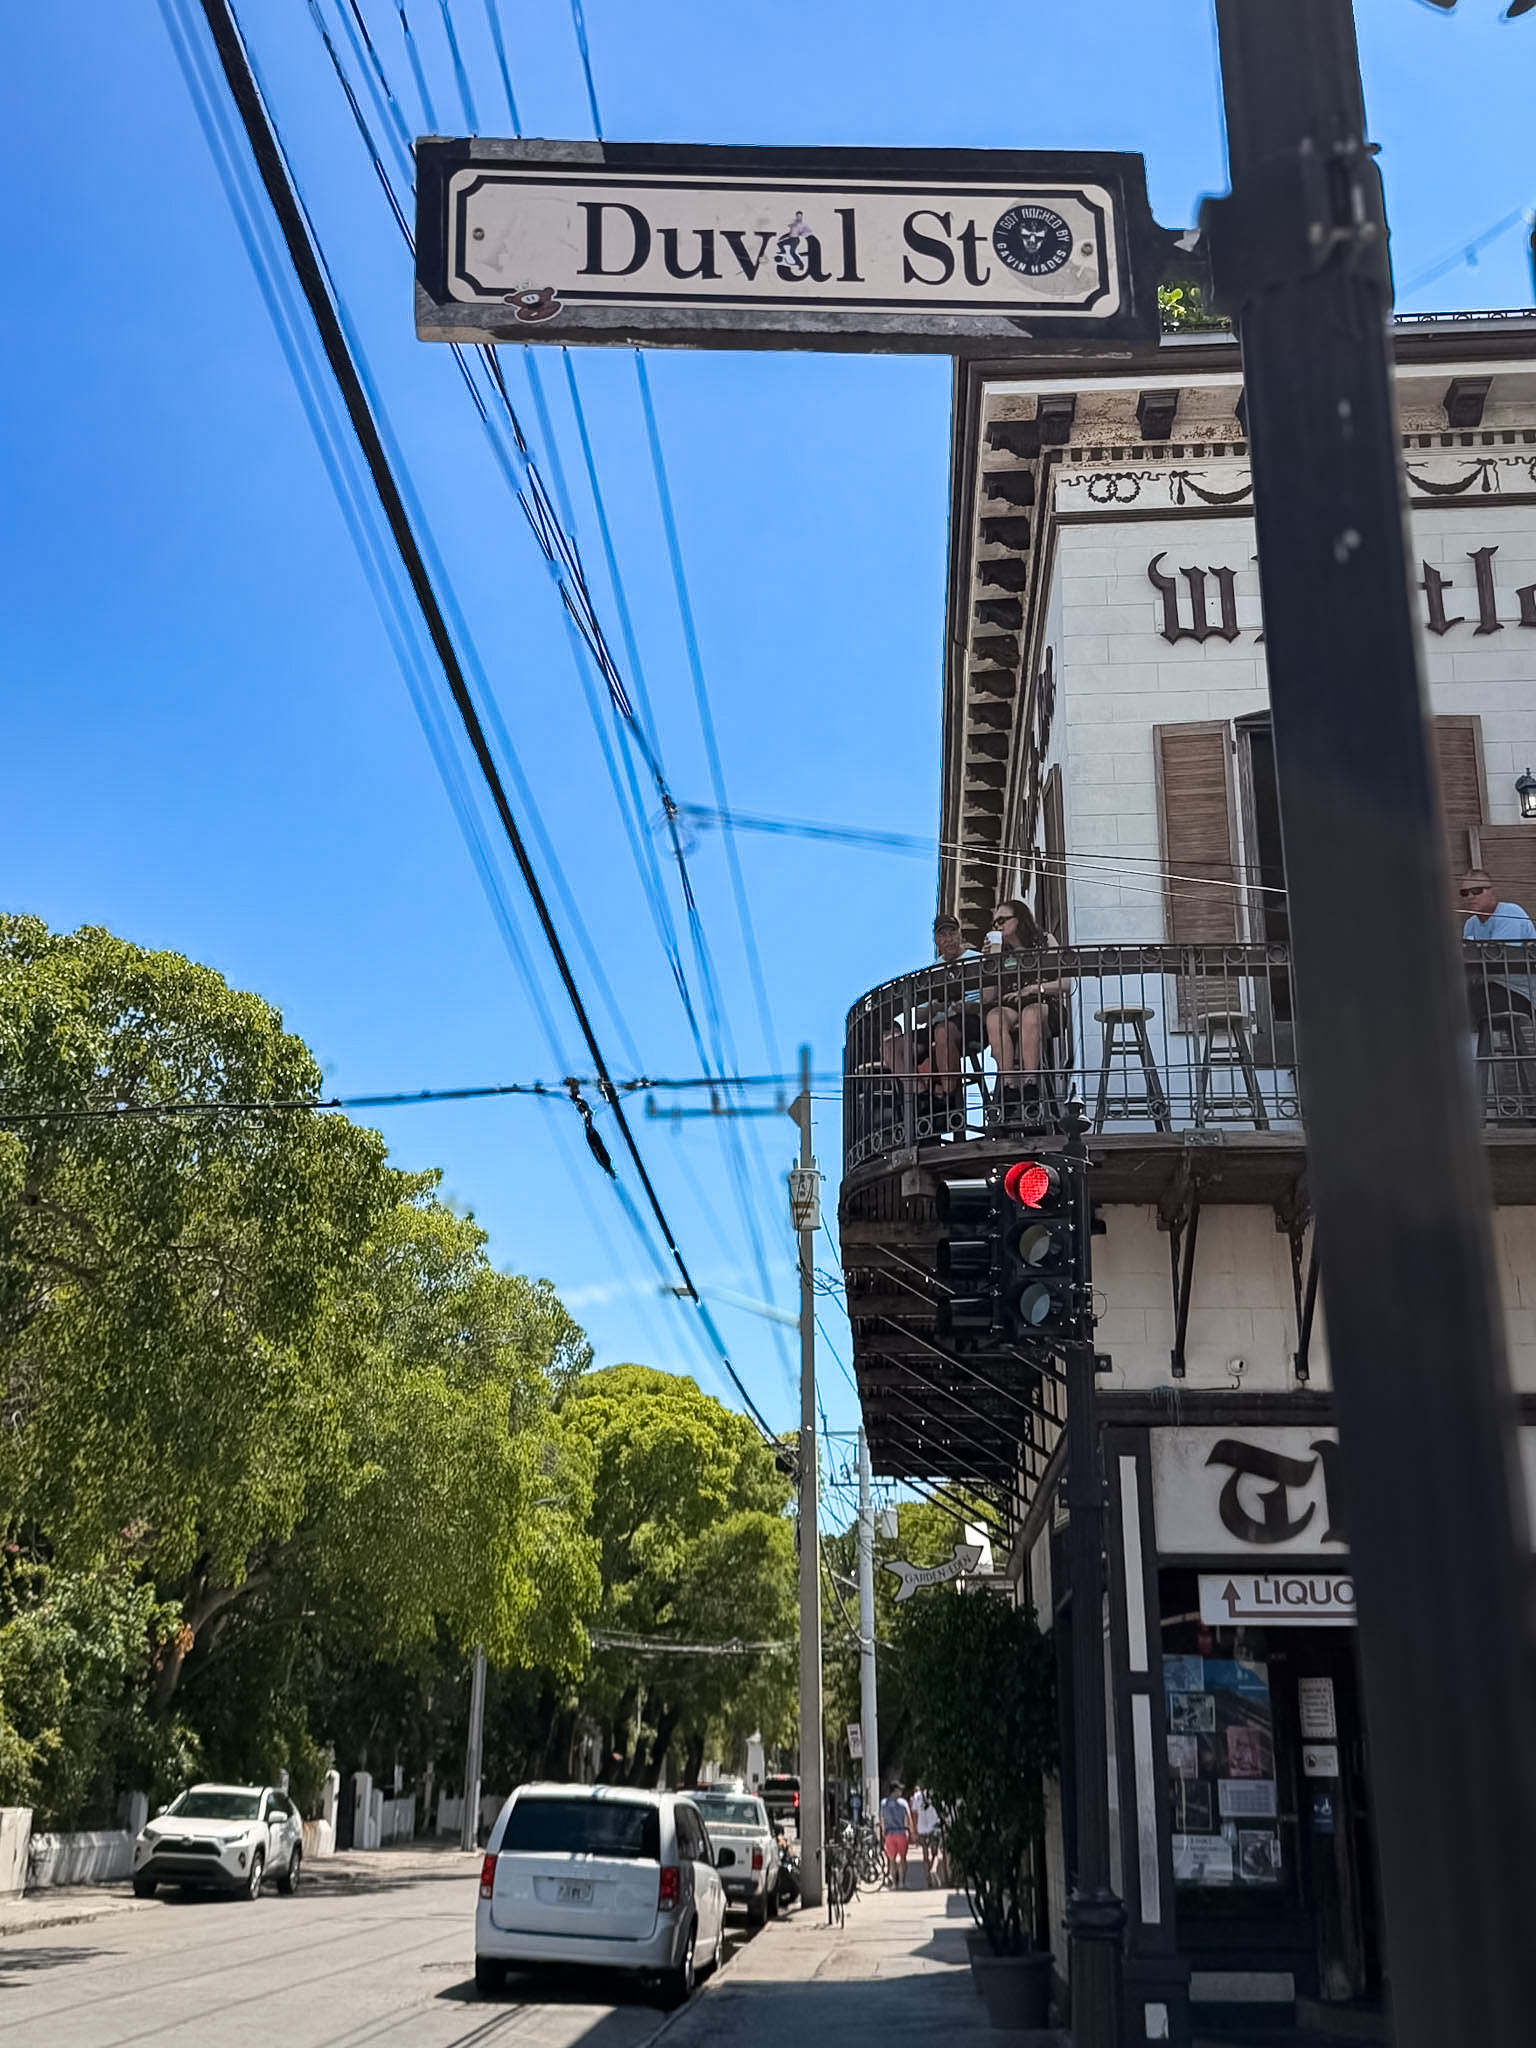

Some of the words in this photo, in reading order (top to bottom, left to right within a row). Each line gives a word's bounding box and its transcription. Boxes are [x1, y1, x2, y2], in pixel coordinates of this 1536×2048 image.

[1000, 212, 1018, 230] GOT
[1056, 229, 1070, 242] BY
[577, 202, 864, 283] Duval
[903, 210, 991, 286] St
[997, 242, 1027, 271] GAVIN
[1031, 249, 1066, 273] HADES
[904, 1568, 946, 1584] GARDEN
